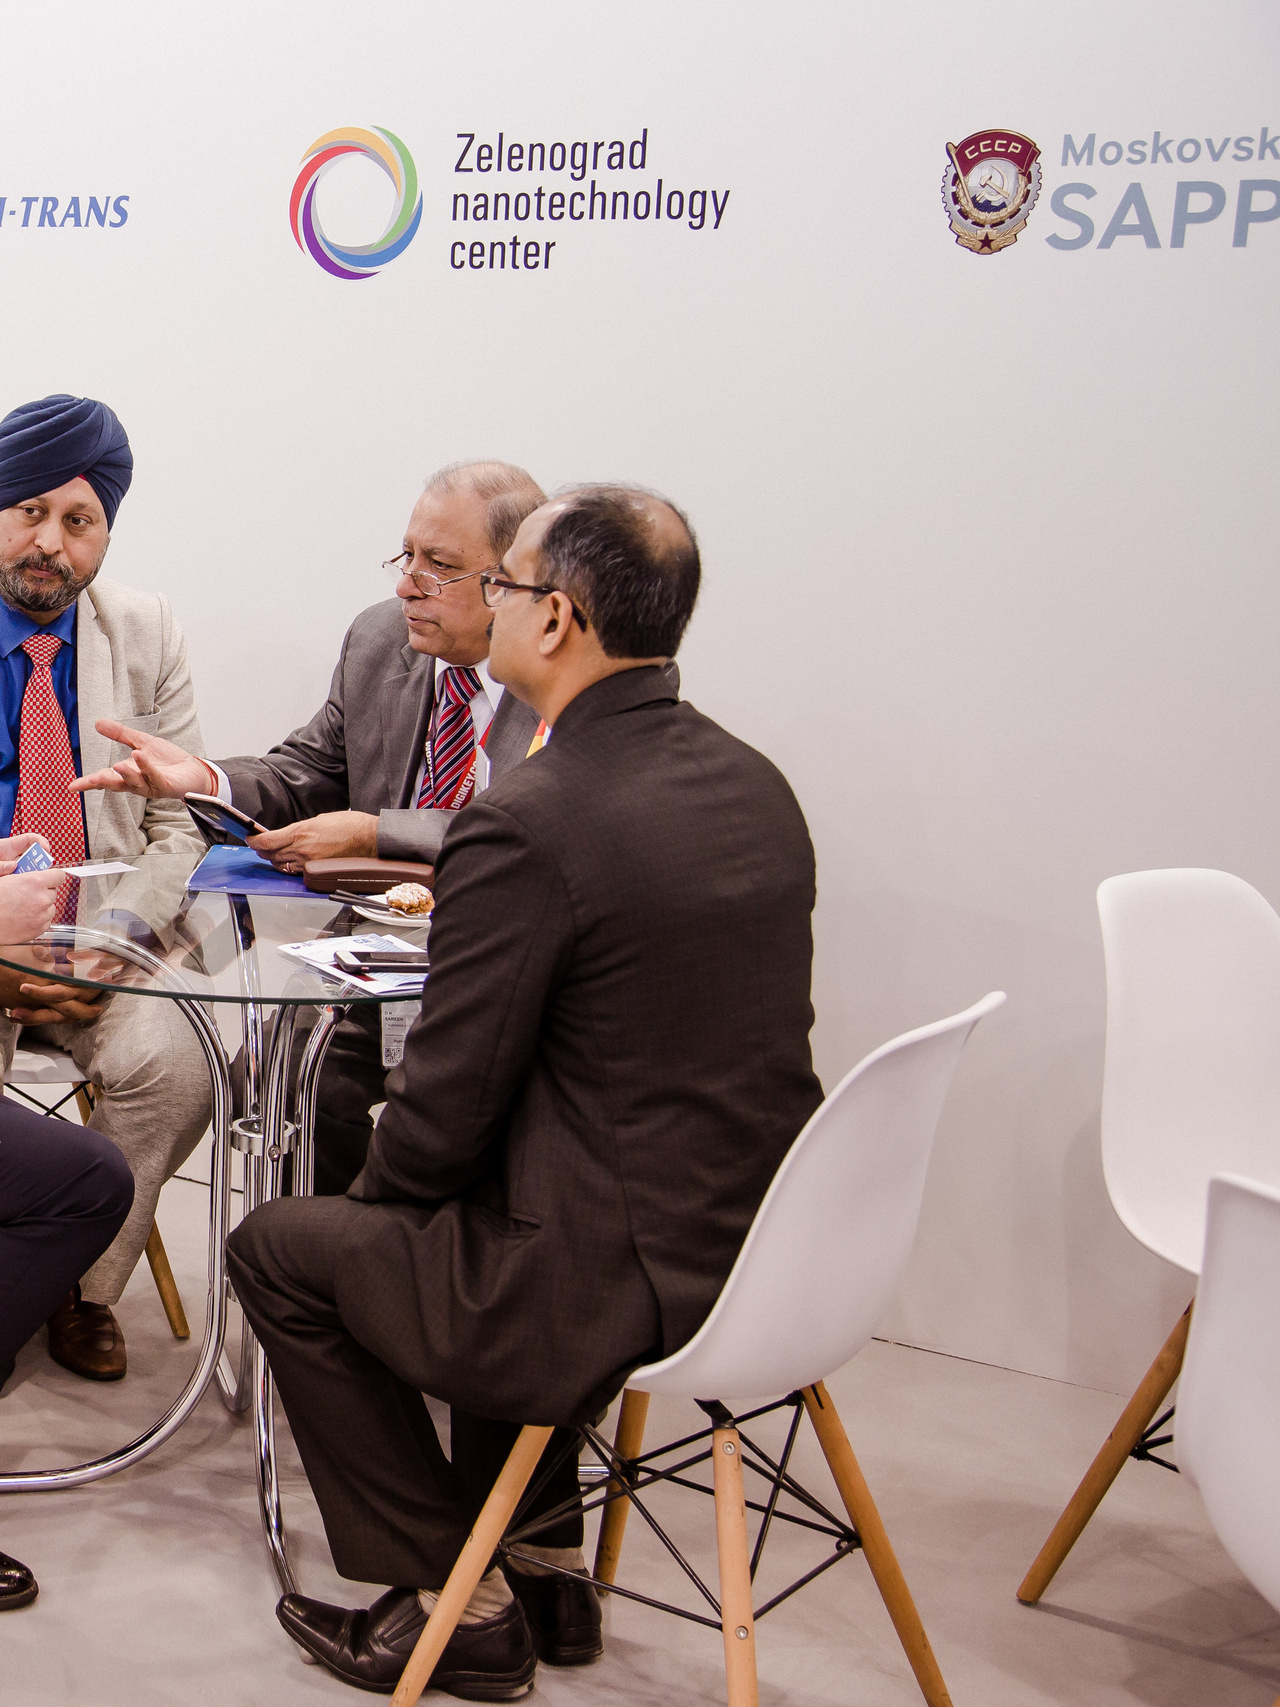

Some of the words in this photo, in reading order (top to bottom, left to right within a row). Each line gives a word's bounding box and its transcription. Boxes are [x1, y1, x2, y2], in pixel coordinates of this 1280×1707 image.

[455, 128, 648, 181] Zelenograd
[452, 180, 730, 230] nanotechnology
[1044, 179, 1280, 251] SAPP
[451, 233, 556, 270] center
